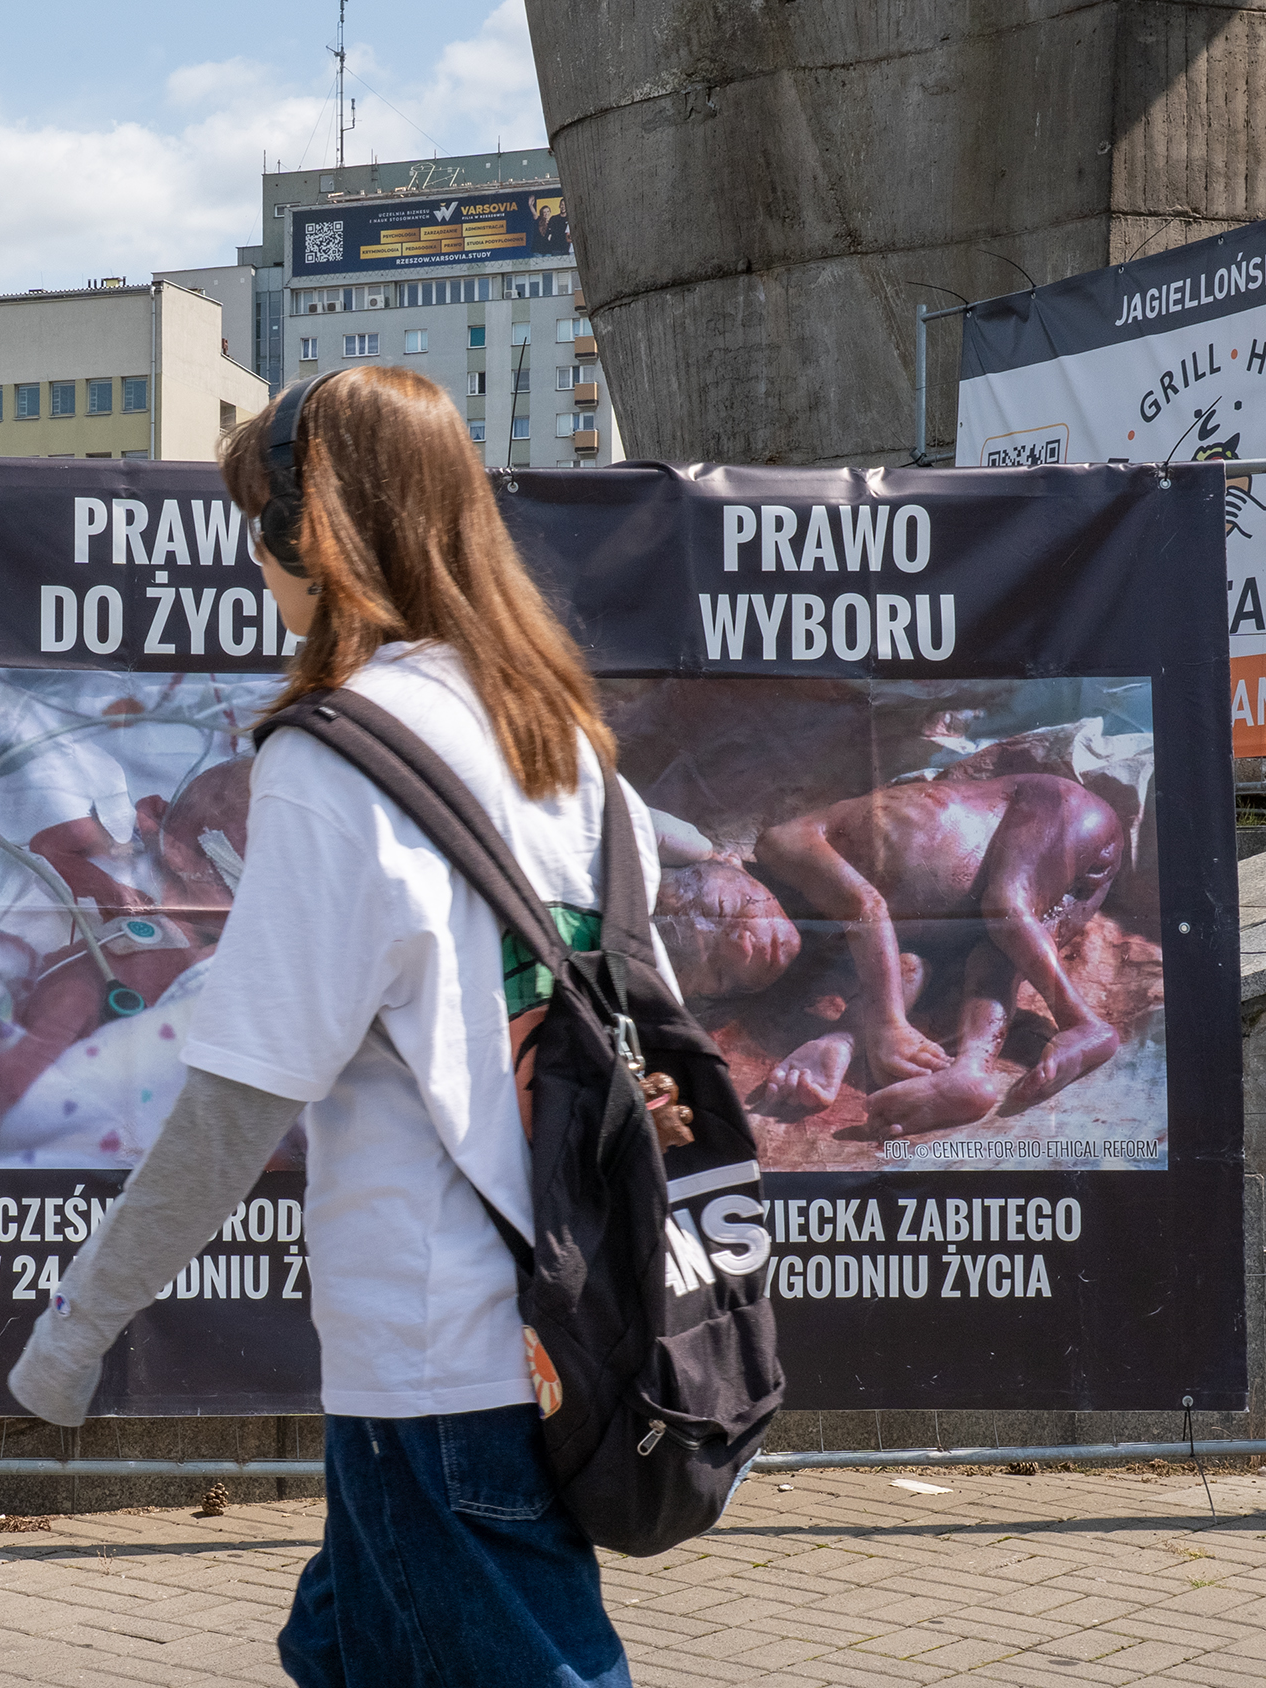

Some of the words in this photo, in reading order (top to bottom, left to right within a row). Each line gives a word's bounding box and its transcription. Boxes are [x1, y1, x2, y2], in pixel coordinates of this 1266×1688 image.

[378, 210, 405, 218] UCZELNIA
[389, 214, 430, 222] STOSOWANYCH
[460, 201, 518, 215] VARSOVIA
[465, 224, 504, 232] ADMINISTRACJA
[395, 251, 492, 265] RZESZOW.VARSOVIA.STUDY
[1115, 252, 1266, 326] JAGIELLOŃS
[1140, 343, 1221, 423] GRILL
[723, 503, 931, 574] PRAWO
[40, 584, 123, 655] DO
[698, 592, 956, 662] WYBORU
[884, 1141, 913, 1159] FOT.
[932, 1140, 984, 1159] CENTER
[987, 1140, 1015, 1159] FOR
[1018, 1140, 1100, 1159] BIO-ETHICAL
[1103, 1139, 1158, 1158] REFORM
[897, 1198, 1082, 1243] ZABITEGO
[665, 1194, 771, 1298] ANS
[941, 1244, 1052, 1298] ŻYCIA
